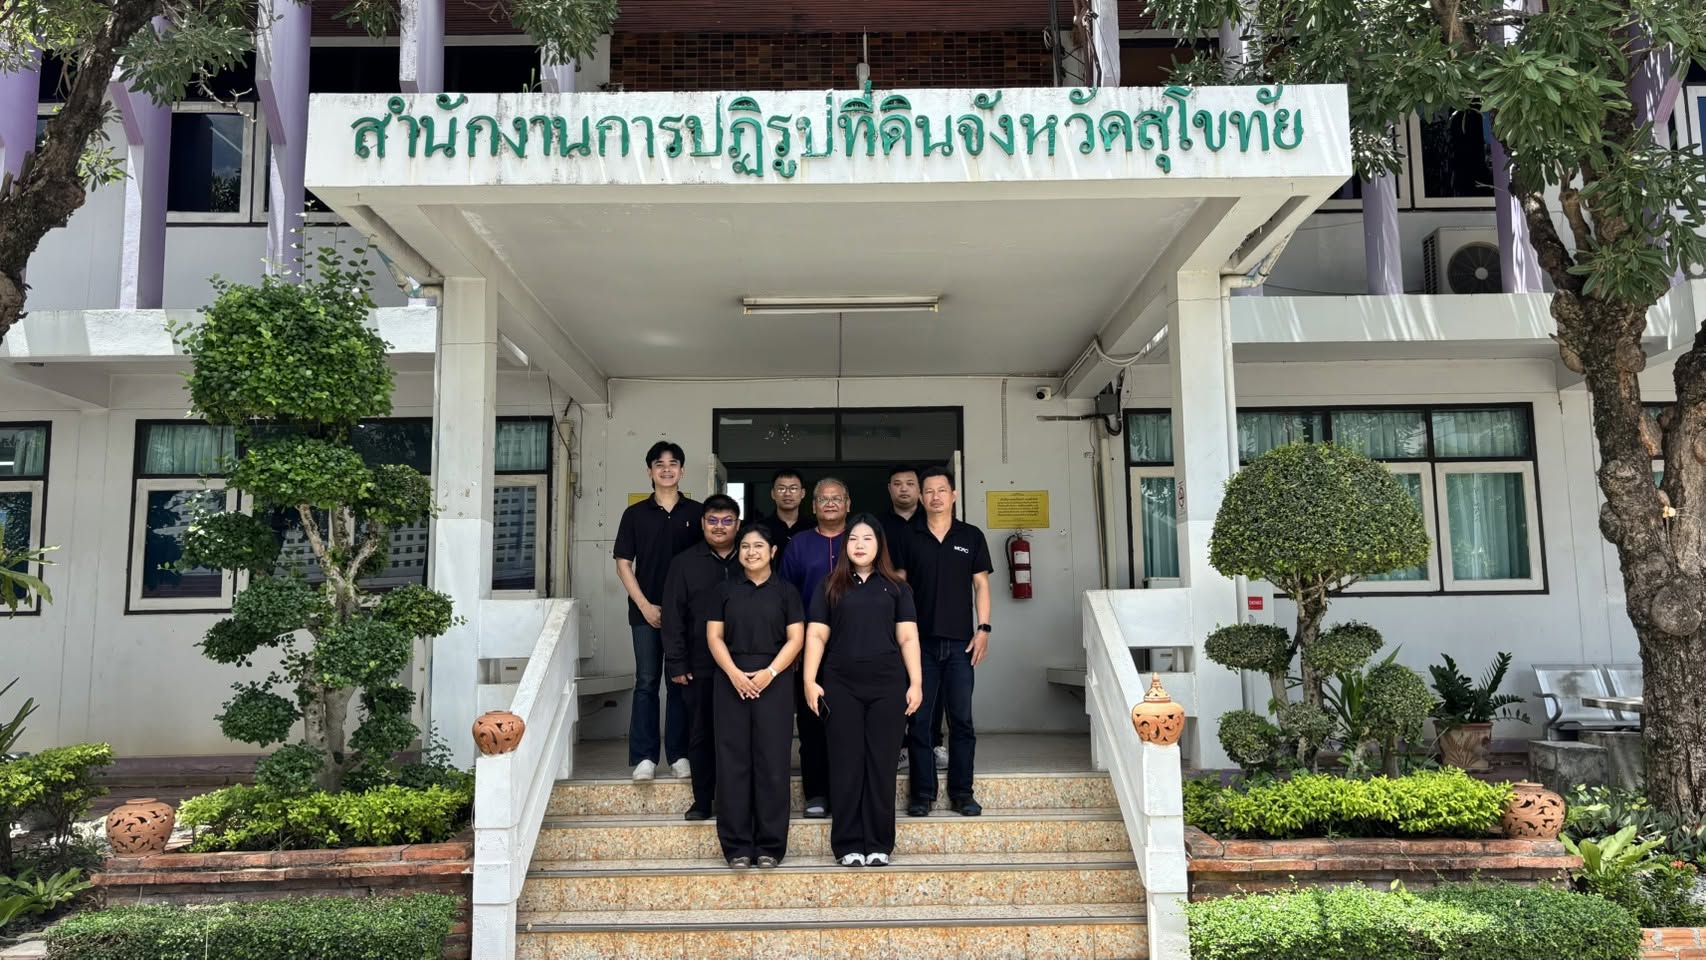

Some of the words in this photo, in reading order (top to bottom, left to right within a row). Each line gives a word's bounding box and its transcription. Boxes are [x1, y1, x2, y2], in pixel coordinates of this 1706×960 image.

[351, 81, 1304, 177] สำนักงานการปฏิรูปที่ดินจังหวัดสุโขทัย
